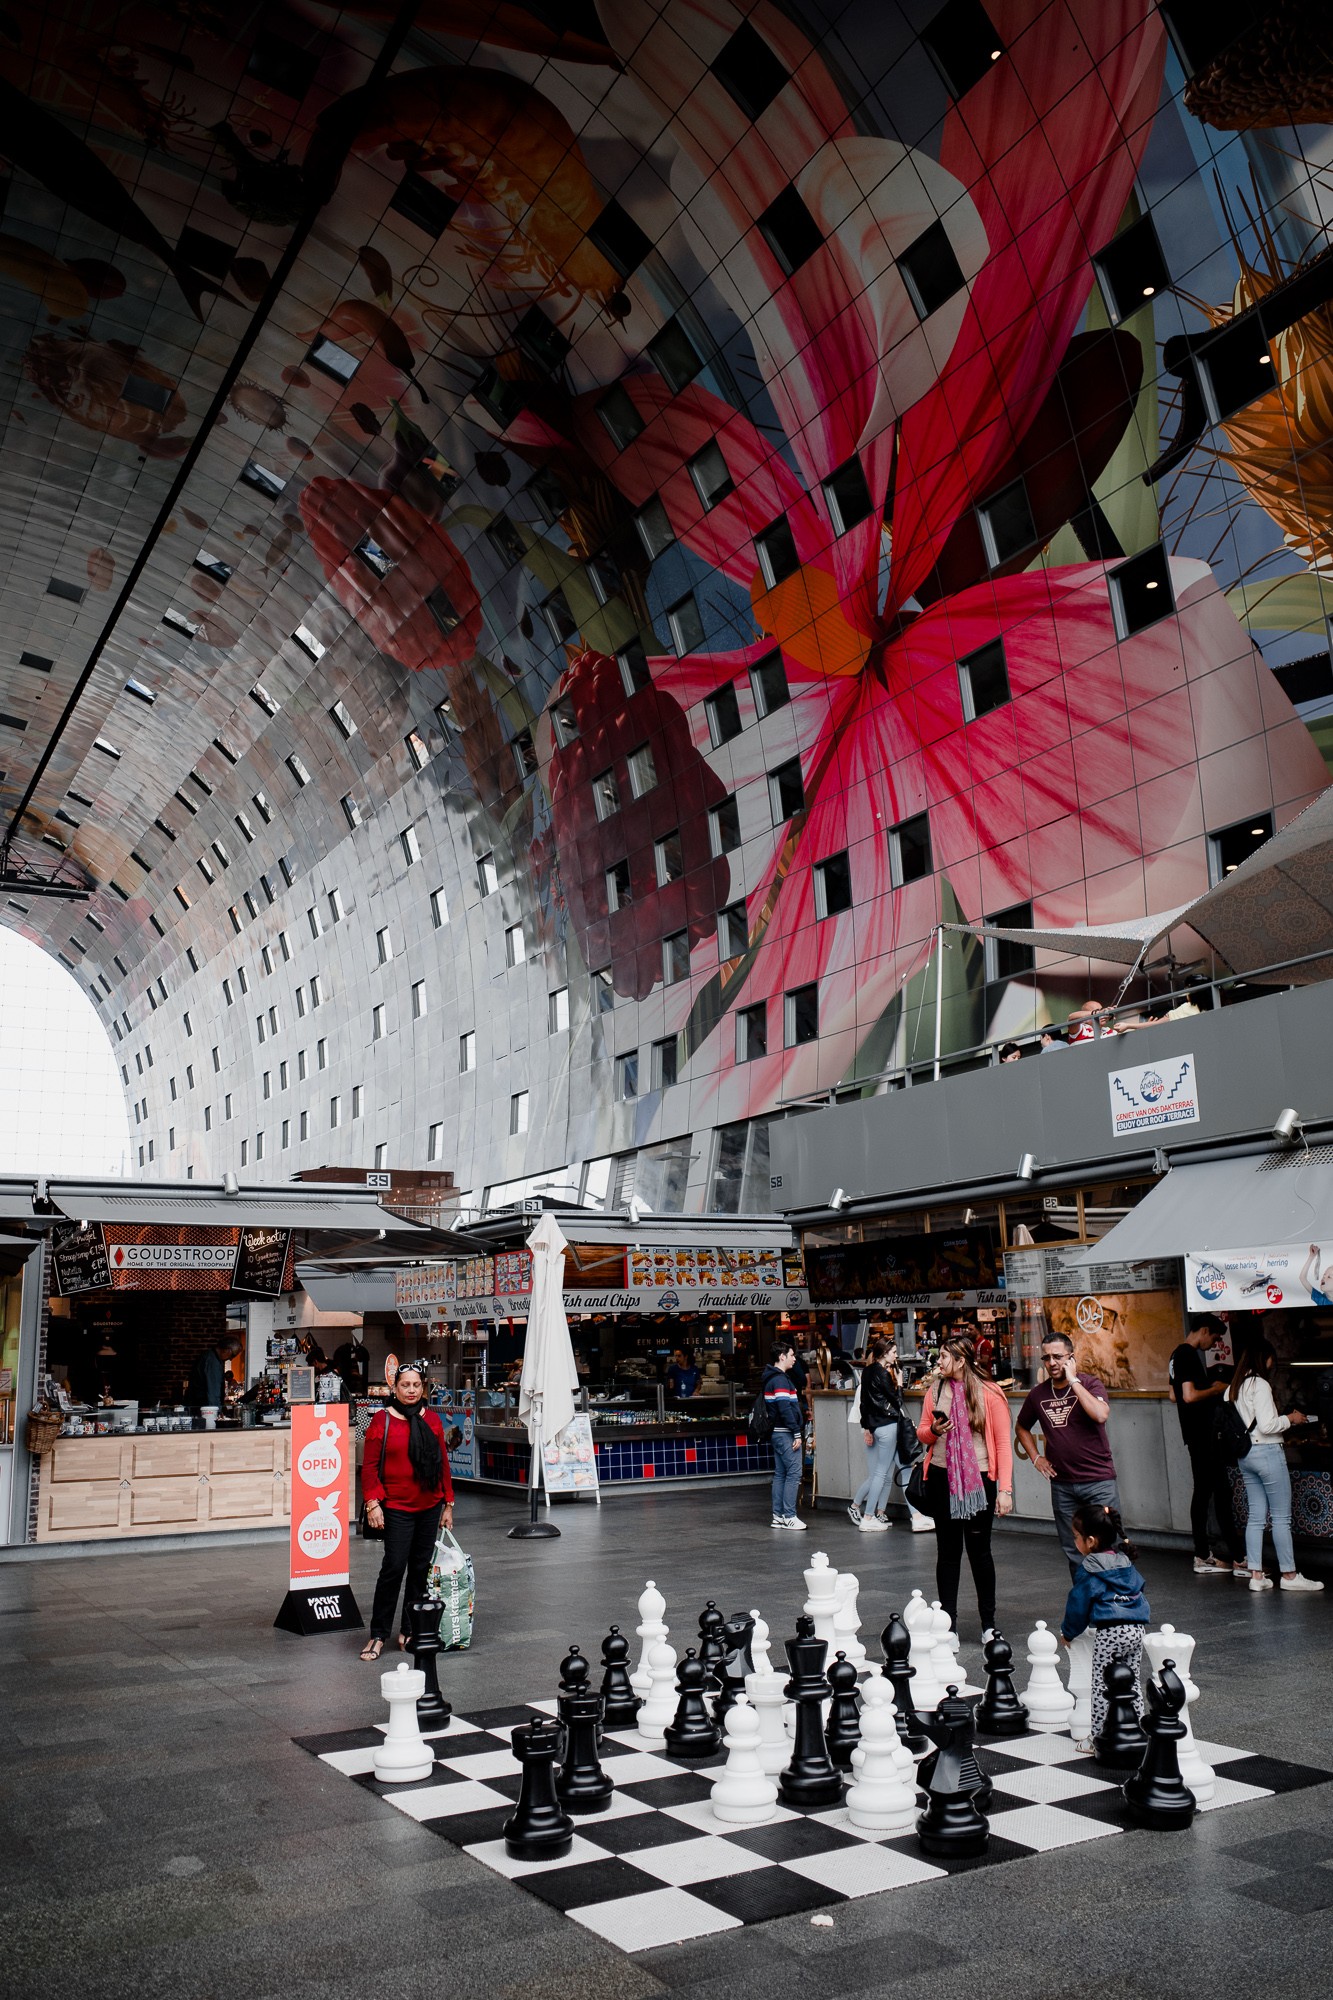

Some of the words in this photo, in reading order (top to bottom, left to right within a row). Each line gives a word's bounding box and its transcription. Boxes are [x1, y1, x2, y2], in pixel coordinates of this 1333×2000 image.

[1140, 1077, 1163, 1090] Andalus
[1152, 1085, 1165, 1094] Fish
[1115, 1111, 1135, 1121] GENIET
[1135, 1109, 1147, 1118] VAN
[1148, 1107, 1160, 1116] ONS
[1160, 1100, 1194, 1114] DAKTERRAS
[1117, 1120, 1136, 1131] ENJOY
[1136, 1118, 1149, 1127] OUR
[1150, 1115, 1167, 1125] ROOF
[1166, 1109, 1194, 1121] TERRACE
[368, 1174, 389, 1187] 39
[771, 1176, 783, 1188] 58
[524, 1201, 541, 1212] 61
[127, 1248, 235, 1261] GOUDSTROOP
[247, 1255, 254, 1263] 10
[1224, 1262, 1239, 1270] losse
[1239, 1260, 1258, 1270] haring
[1266, 1259, 1289, 1268] herring
[1195, 1271, 1226, 1285] Andalus
[1211, 1280, 1228, 1291] Fish
[562, 1294, 582, 1307] Fish
[584, 1294, 610, 1307] and
[609, 1293, 641, 1310] Chips
[698, 1293, 748, 1308] Arachide
[751, 1293, 772, 1306] Olie
[977, 1291, 995, 1304] Fish
[996, 1293, 1007, 1303] an
[705, 1336, 724, 1345] BEER
[1049, 1400, 1068, 1408] ARMANI
[302, 1458, 337, 1471] OPEN
[303, 1528, 338, 1542] OPEN
[307, 1594, 340, 1607] MARKT
[313, 1601, 342, 1620] HAL
[449, 1575, 461, 1645] marskramer
